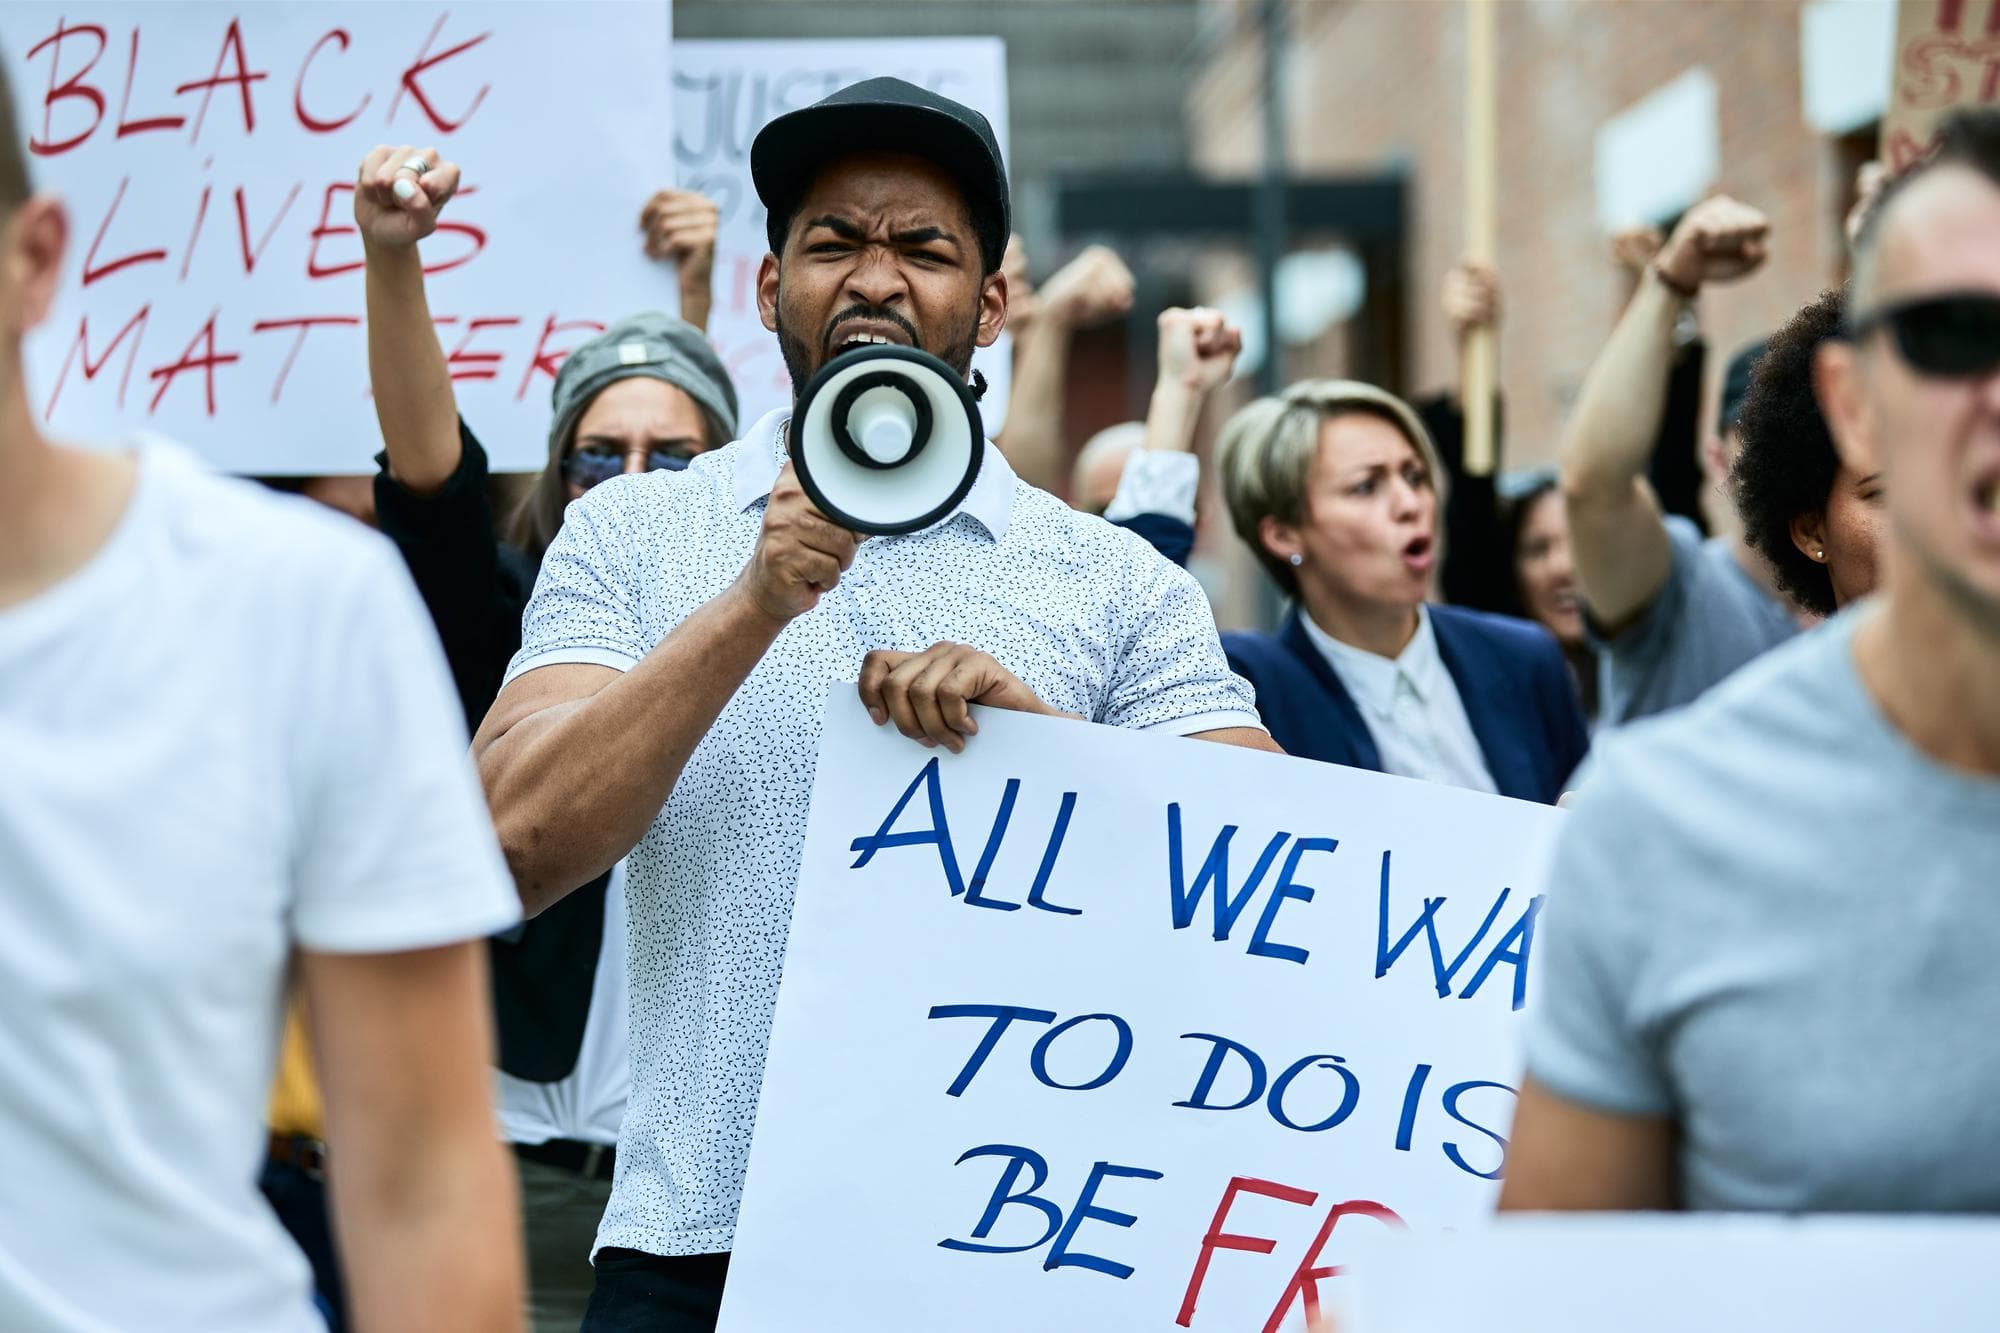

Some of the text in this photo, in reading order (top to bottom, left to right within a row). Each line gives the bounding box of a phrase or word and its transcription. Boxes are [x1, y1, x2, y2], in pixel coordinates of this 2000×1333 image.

[26, 13, 494, 156] BLACK
[44, 303, 607, 422] MATER
[850, 757, 1083, 916] ALL
[1167, 802, 1339, 964] WE
[928, 1004, 1521, 1181] TO DO IS
[937, 1143, 1164, 1280] BE
